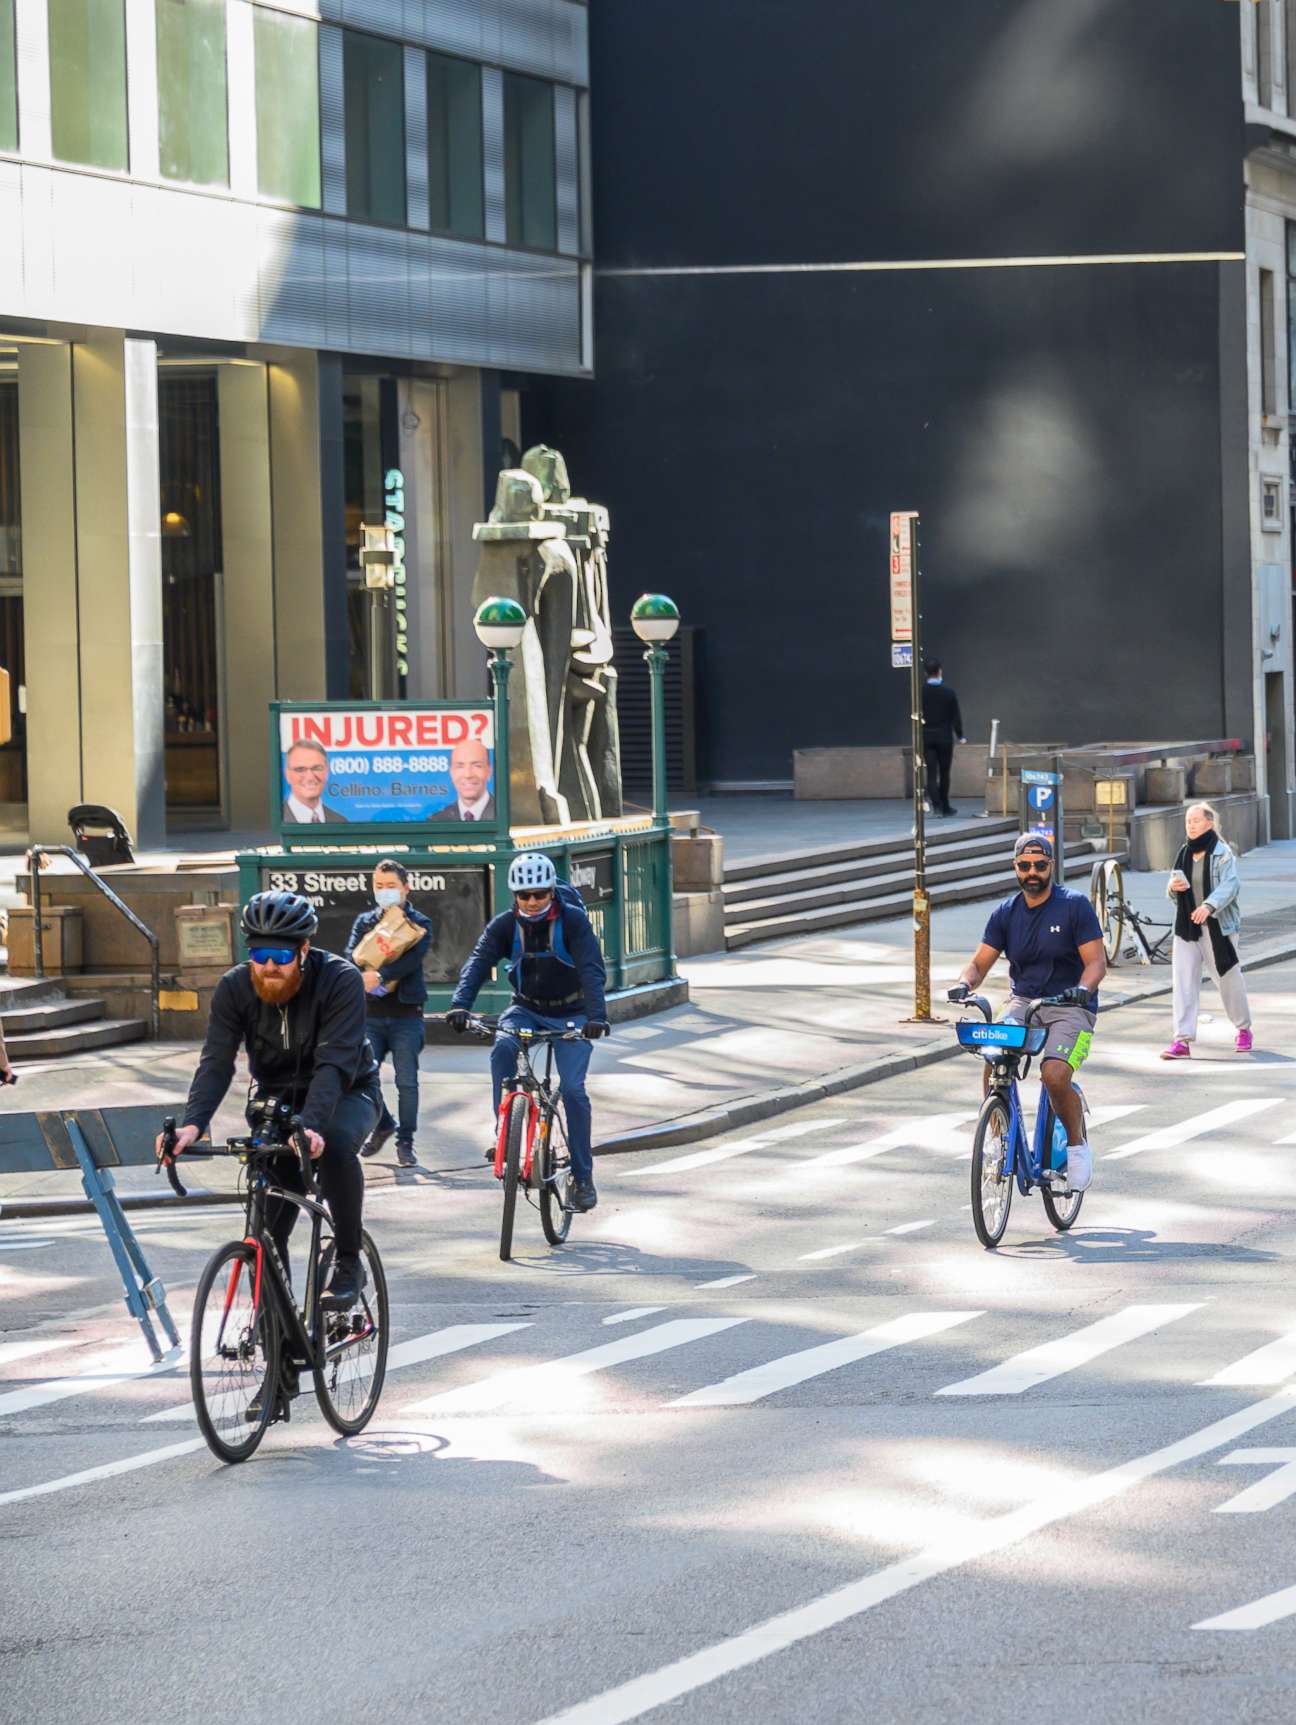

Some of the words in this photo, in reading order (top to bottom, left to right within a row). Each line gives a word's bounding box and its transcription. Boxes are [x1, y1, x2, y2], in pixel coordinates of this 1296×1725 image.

[291, 713, 489, 747] INJURED?
[330, 756, 369, 775] (800)
[372, 755, 449, 773] 888-8888
[391, 781, 448, 797] Barnes
[1036, 787, 1052, 807] P
[271, 873, 299, 892] 33
[304, 872, 367, 892] Street
[407, 872, 446, 892] tion
